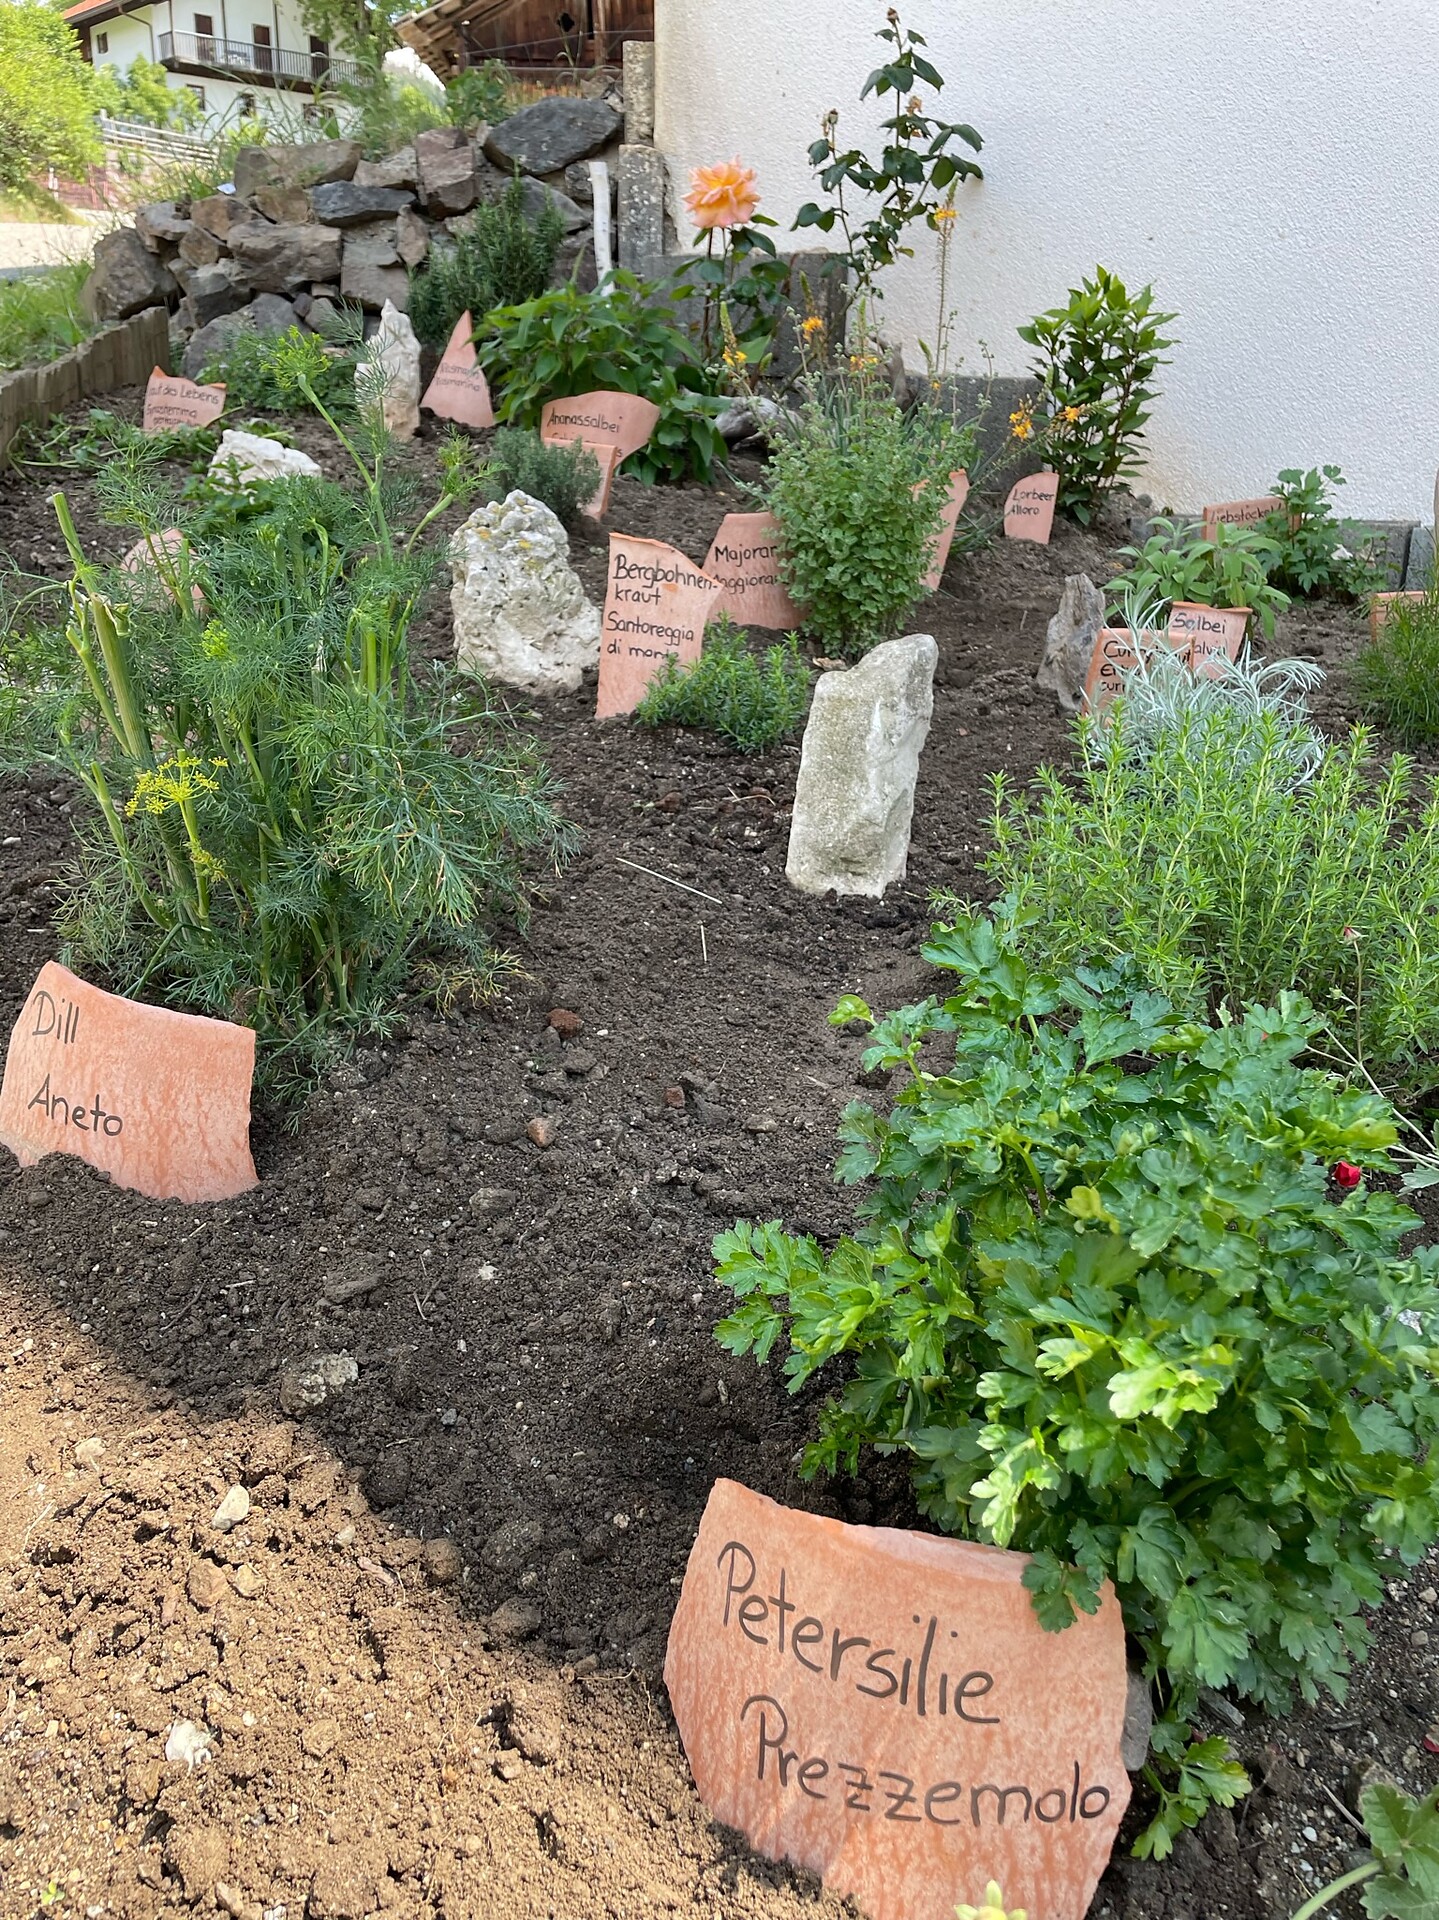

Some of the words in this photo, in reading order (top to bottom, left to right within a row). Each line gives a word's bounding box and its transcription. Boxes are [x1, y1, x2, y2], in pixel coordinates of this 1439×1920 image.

[181, 384, 219, 405] Lebens
[547, 407, 622, 433] Ananassalbei
[1013, 488, 1055, 502] Lorbeer
[612, 553, 718, 590] Bergbohnen-
[615, 583, 661, 605] kraut
[605, 611, 695, 646] Santoreggia
[1172, 612, 1226, 634] Salbei
[607, 639, 622, 654] di
[32, 990, 79, 1044] Dill
[28, 1073, 123, 1136] Aneto
[717, 1541, 1000, 1723] Petersilie
[740, 1695, 1110, 1826] Prezzemolo
